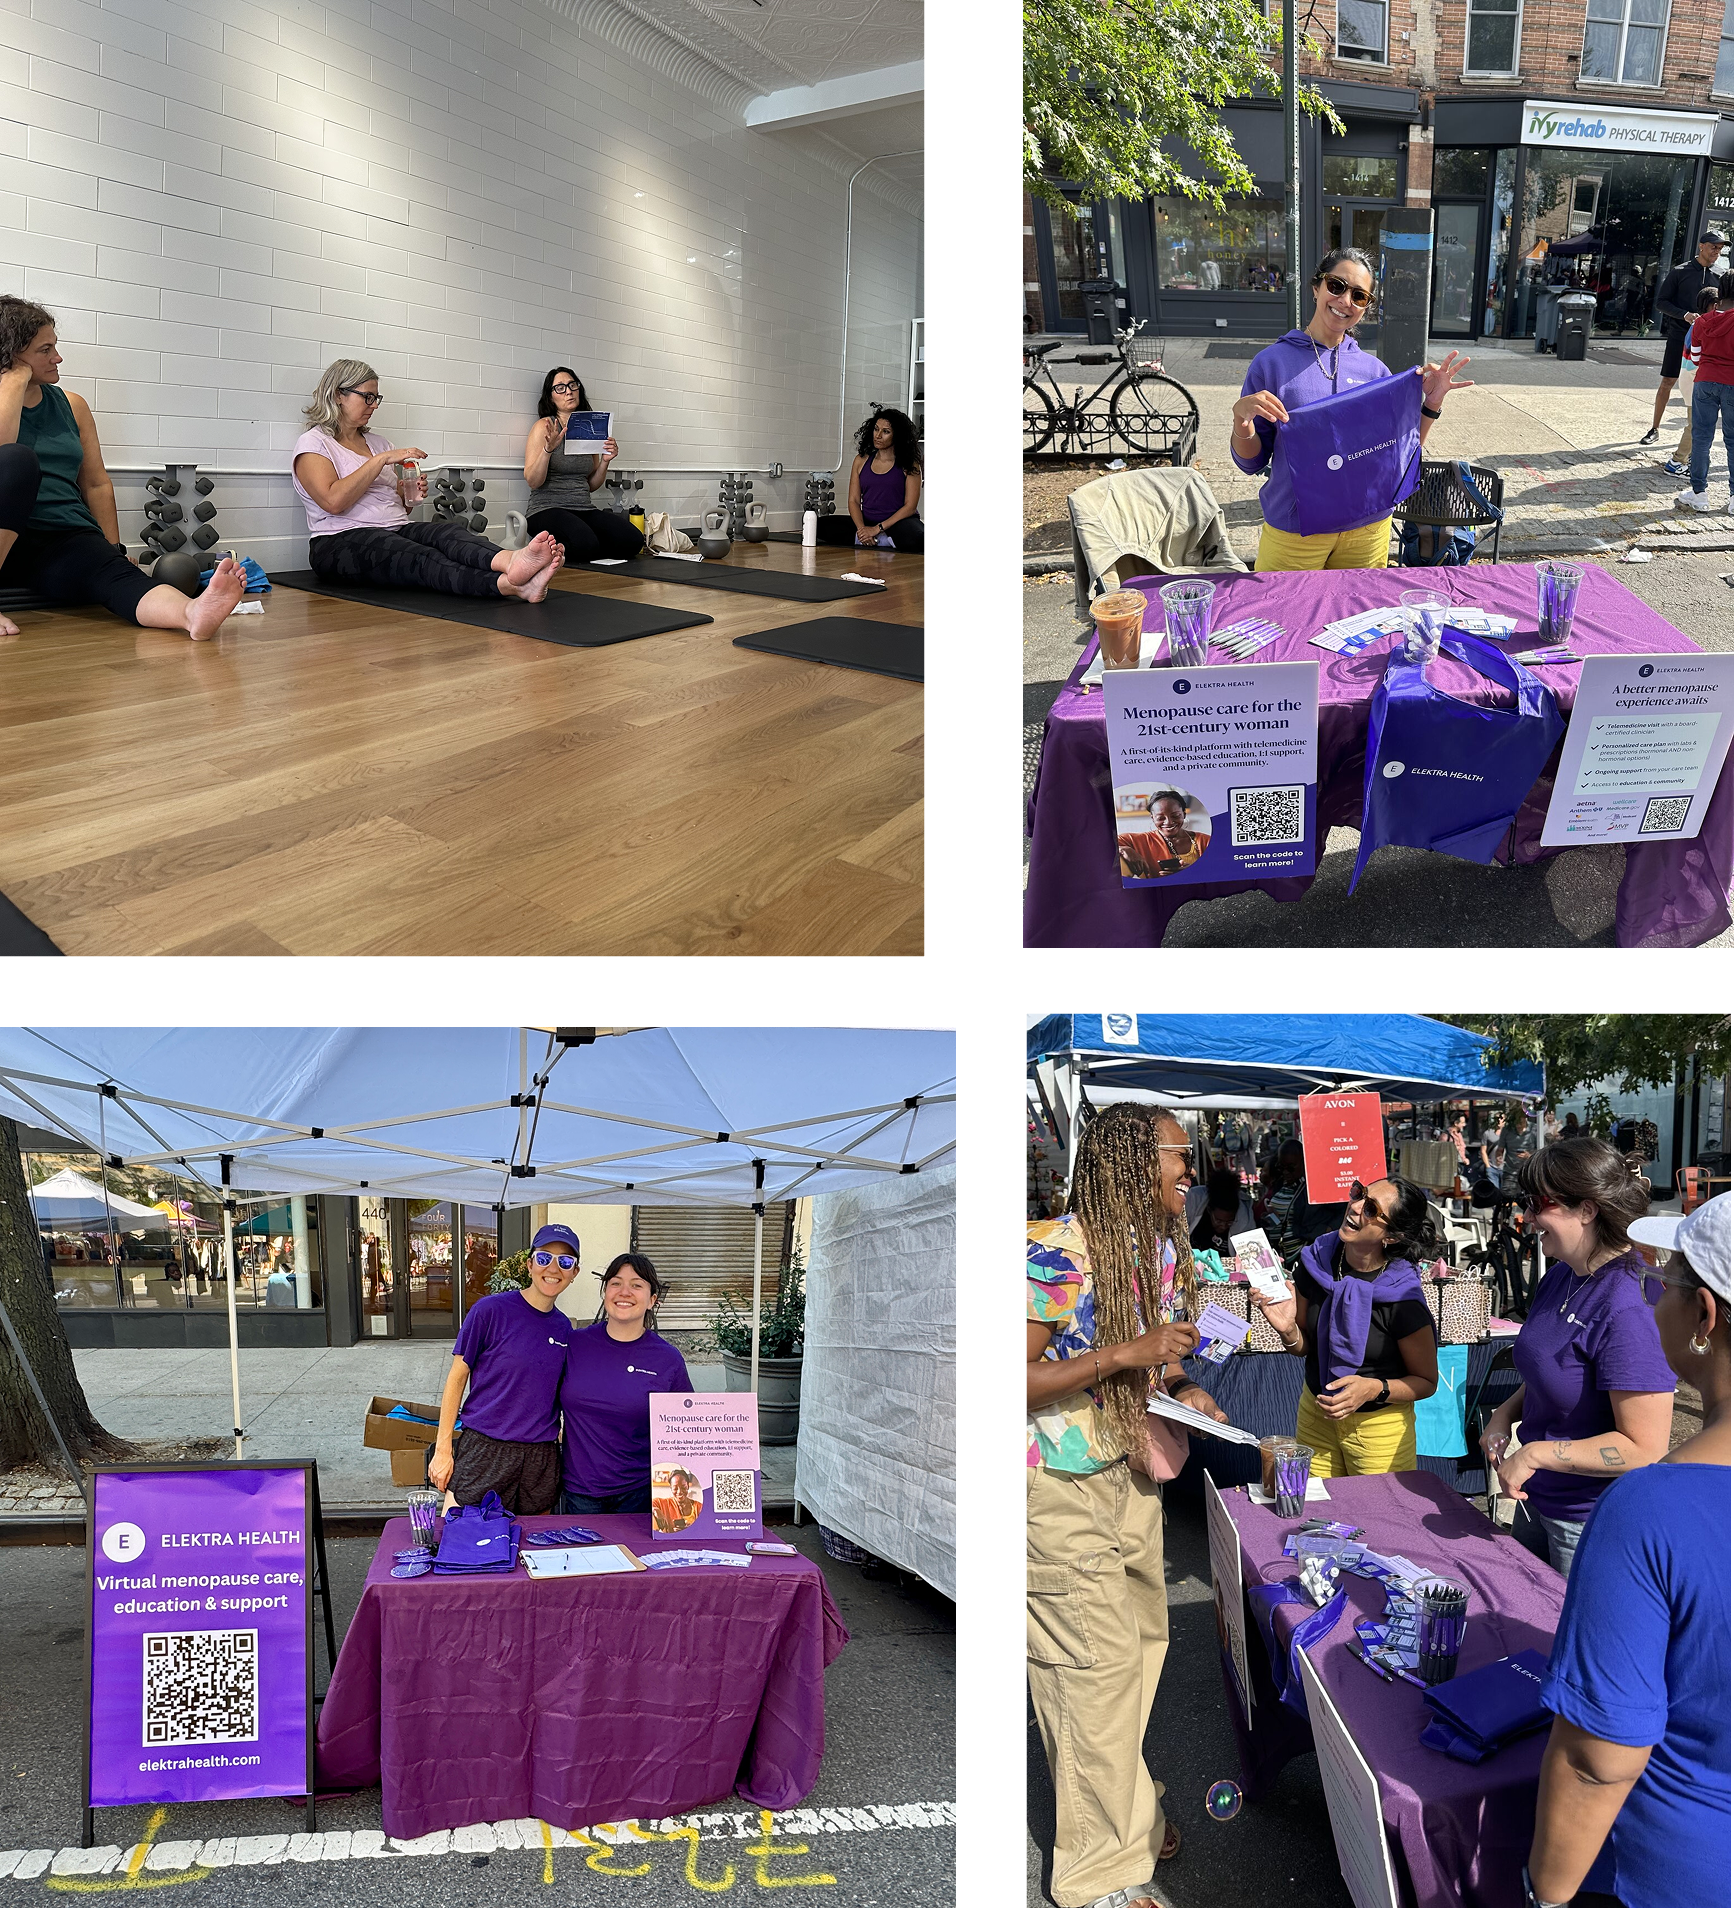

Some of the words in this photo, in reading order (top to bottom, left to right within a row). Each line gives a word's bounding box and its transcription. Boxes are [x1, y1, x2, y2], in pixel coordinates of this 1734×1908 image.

[1609, 128, 1657, 142] PHYSICAL
[1660, 132, 1705, 145] THERAPY
[1351, 174, 1369, 182] 1414
[1714, 196, 1734, 208] 1412
[1441, 236, 1458, 245] 1412
[1207, 249, 1247, 262] honey
[1348, 448, 1374, 460] ELEKTRA
[1374, 438, 1396, 450] HEALTH
[1612, 685, 1620, 694] A
[1623, 684, 1656, 694] better
[1658, 684, 1718, 694] menopause
[1616, 697, 1674, 708] experience
[1674, 696, 1708, 705] awaits
[1123, 706, 1213, 720] Menopause
[1216, 704, 1249, 715] care
[1252, 700, 1274, 713] for
[1278, 698, 1302, 712] the
[1138, 720, 1230, 736] 21st-century
[1234, 718, 1289, 730] woman
[1129, 745, 1192, 754] first-of-its-kind
[1194, 743, 1232, 752] platform
[1254, 738, 1307, 748] telemedicine
[1147, 752, 1211, 764] evidence-based
[1213, 750, 1257, 760] education,
[1270, 748, 1304, 758] support,
[1187, 763, 1217, 772] private
[1218, 759, 1268, 768] community.
[1412, 768, 1448, 777] ELEKTRA
[1450, 772, 1484, 782] HEALTH
[1324, 1100, 1355, 1108] AVON
[362, 1208, 386, 1220] 440
[659, 1414, 704, 1424] Menopause
[724, 1414, 736, 1422] for
[736, 1414, 750, 1422] the
[666, 1425, 713, 1434] 21st-century
[119, 1534, 130, 1549] E
[161, 1533, 234, 1548] ELEKTRA
[238, 1530, 300, 1545] HEALTH
[97, 1574, 156, 1590] Virtual
[161, 1572, 260, 1590] menopause
[264, 1572, 304, 1586] care,
[114, 1598, 200, 1614] education
[204, 1596, 217, 1610] &
[220, 1595, 288, 1612] support
[139, 1754, 260, 1772] elektrahealth.com
